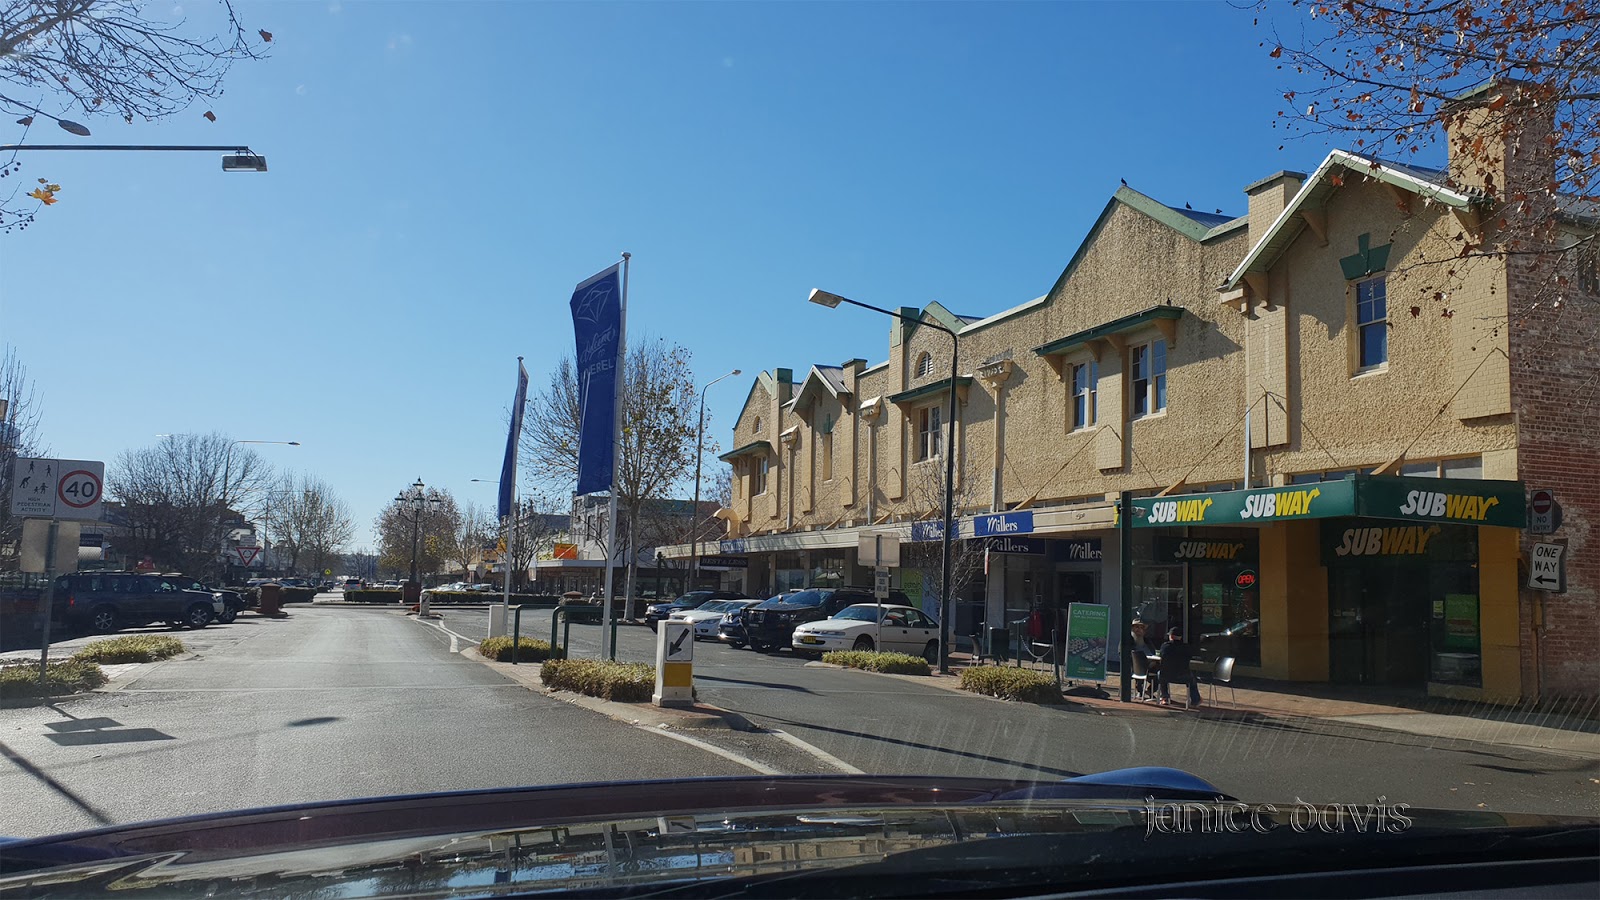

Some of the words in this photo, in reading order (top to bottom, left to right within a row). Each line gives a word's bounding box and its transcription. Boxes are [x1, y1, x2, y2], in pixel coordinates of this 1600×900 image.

[65, 481, 95, 498] 40
[1148, 497, 1213, 524] SUBWAY
[1240, 487, 1320, 520] SUBWAY
[1399, 490, 1499, 521] SUBWAY
[986, 515, 1018, 533] Millers
[983, 536, 1029, 553] Millers
[1335, 524, 1442, 557] SUBWAY
[1069, 542, 1103, 559] Millers
[1174, 541, 1244, 559] SUBWAY
[1536, 546, 1558, 558] ONE
[1534, 560, 1557, 573] WAY
[1238, 574, 1255, 584] OPEN
[1073, 609, 1106, 617] CATERING
